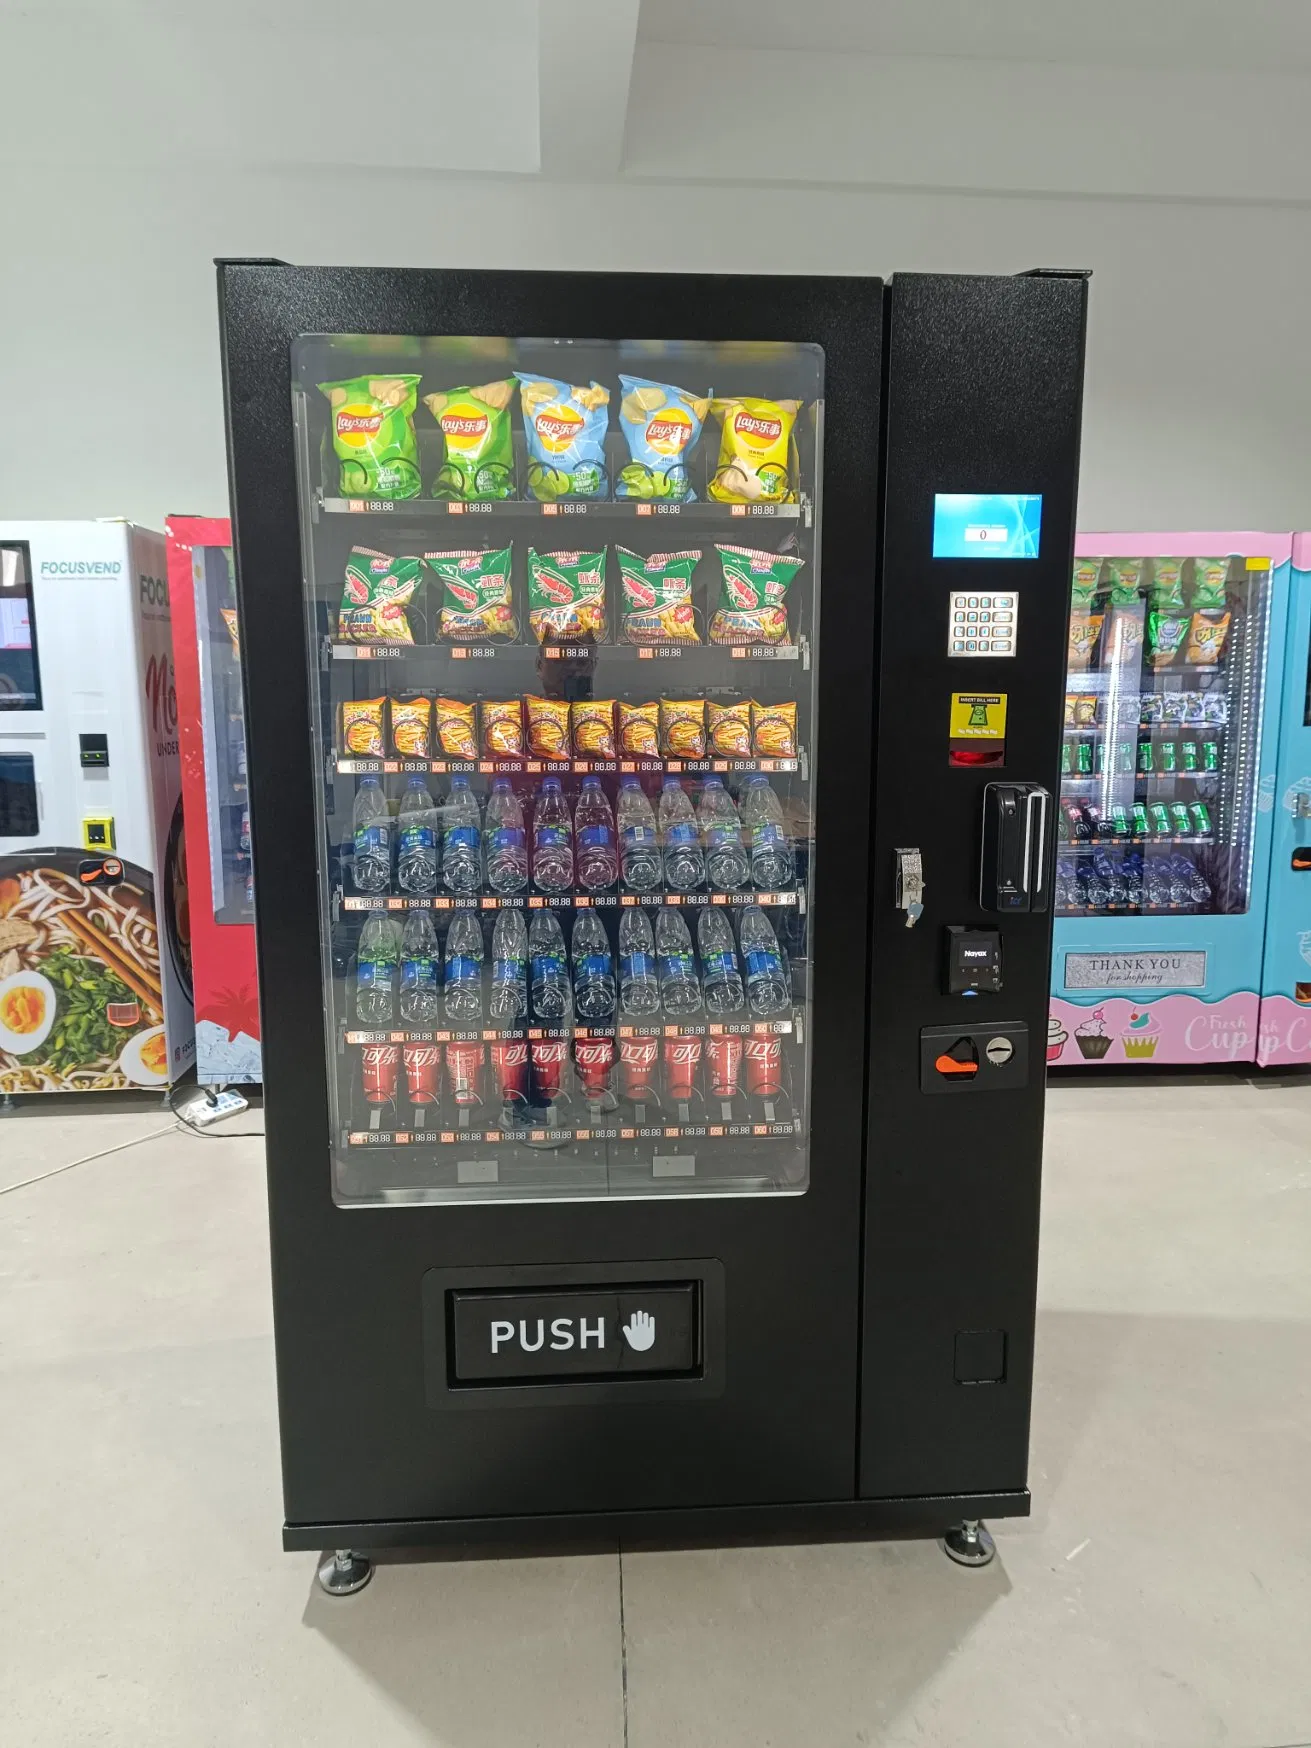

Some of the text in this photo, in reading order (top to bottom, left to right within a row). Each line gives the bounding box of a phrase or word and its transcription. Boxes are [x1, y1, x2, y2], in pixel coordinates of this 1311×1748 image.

[338, 417, 360, 430] Lay's
[442, 419, 464, 432] Lay's
[649, 423, 672, 436] Lay's
[736, 415, 759, 431] Lay's
[759, 423, 780, 435] 乐事
[41, 561, 121, 574] FOCUSVEND
[964, 950, 988, 958] Nayax
[1090, 959, 1182, 971] THANK YOU
[1106, 973, 1163, 985] for shopping
[1210, 1015, 1246, 1029] Fresh
[491, 1317, 605, 1354] PUSH
